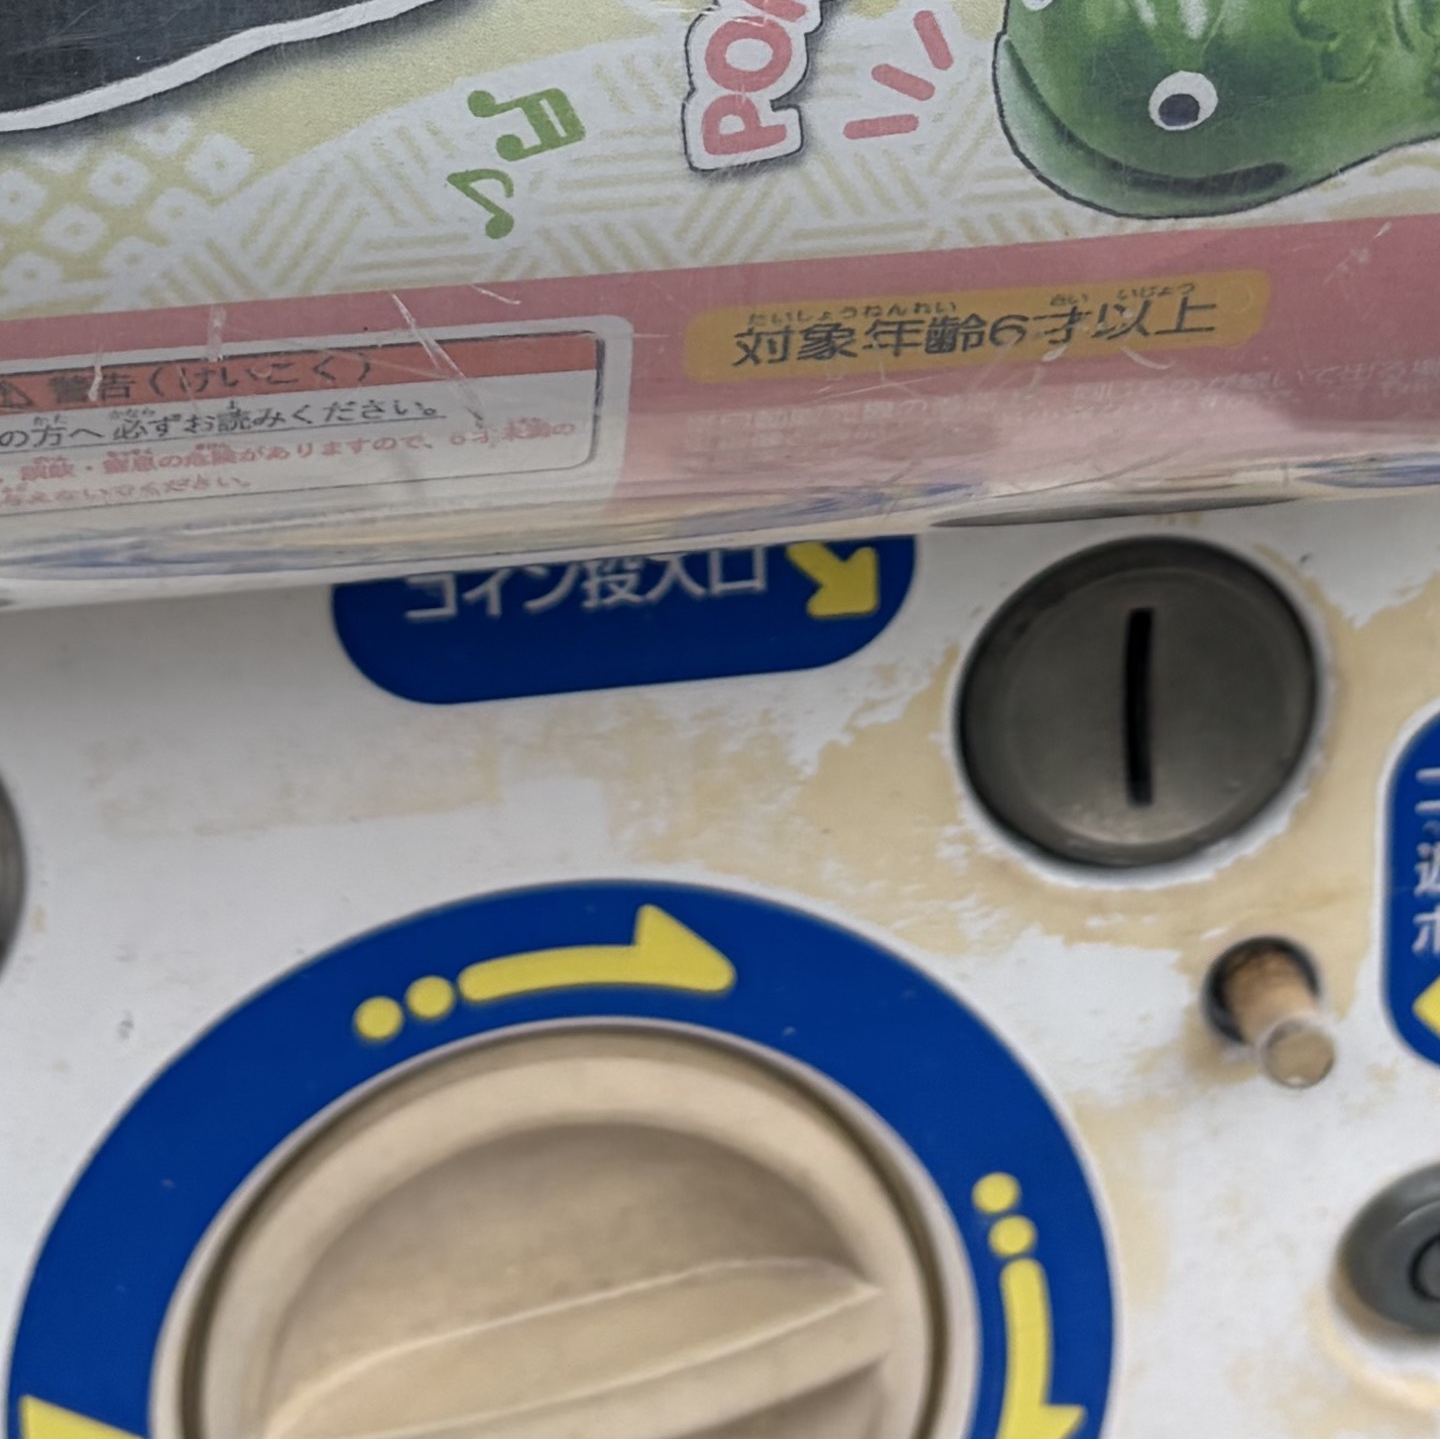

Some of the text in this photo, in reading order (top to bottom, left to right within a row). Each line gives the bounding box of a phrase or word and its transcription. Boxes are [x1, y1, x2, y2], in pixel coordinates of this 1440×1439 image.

[731, 295, 1218, 368] 対象年齢6才以上
